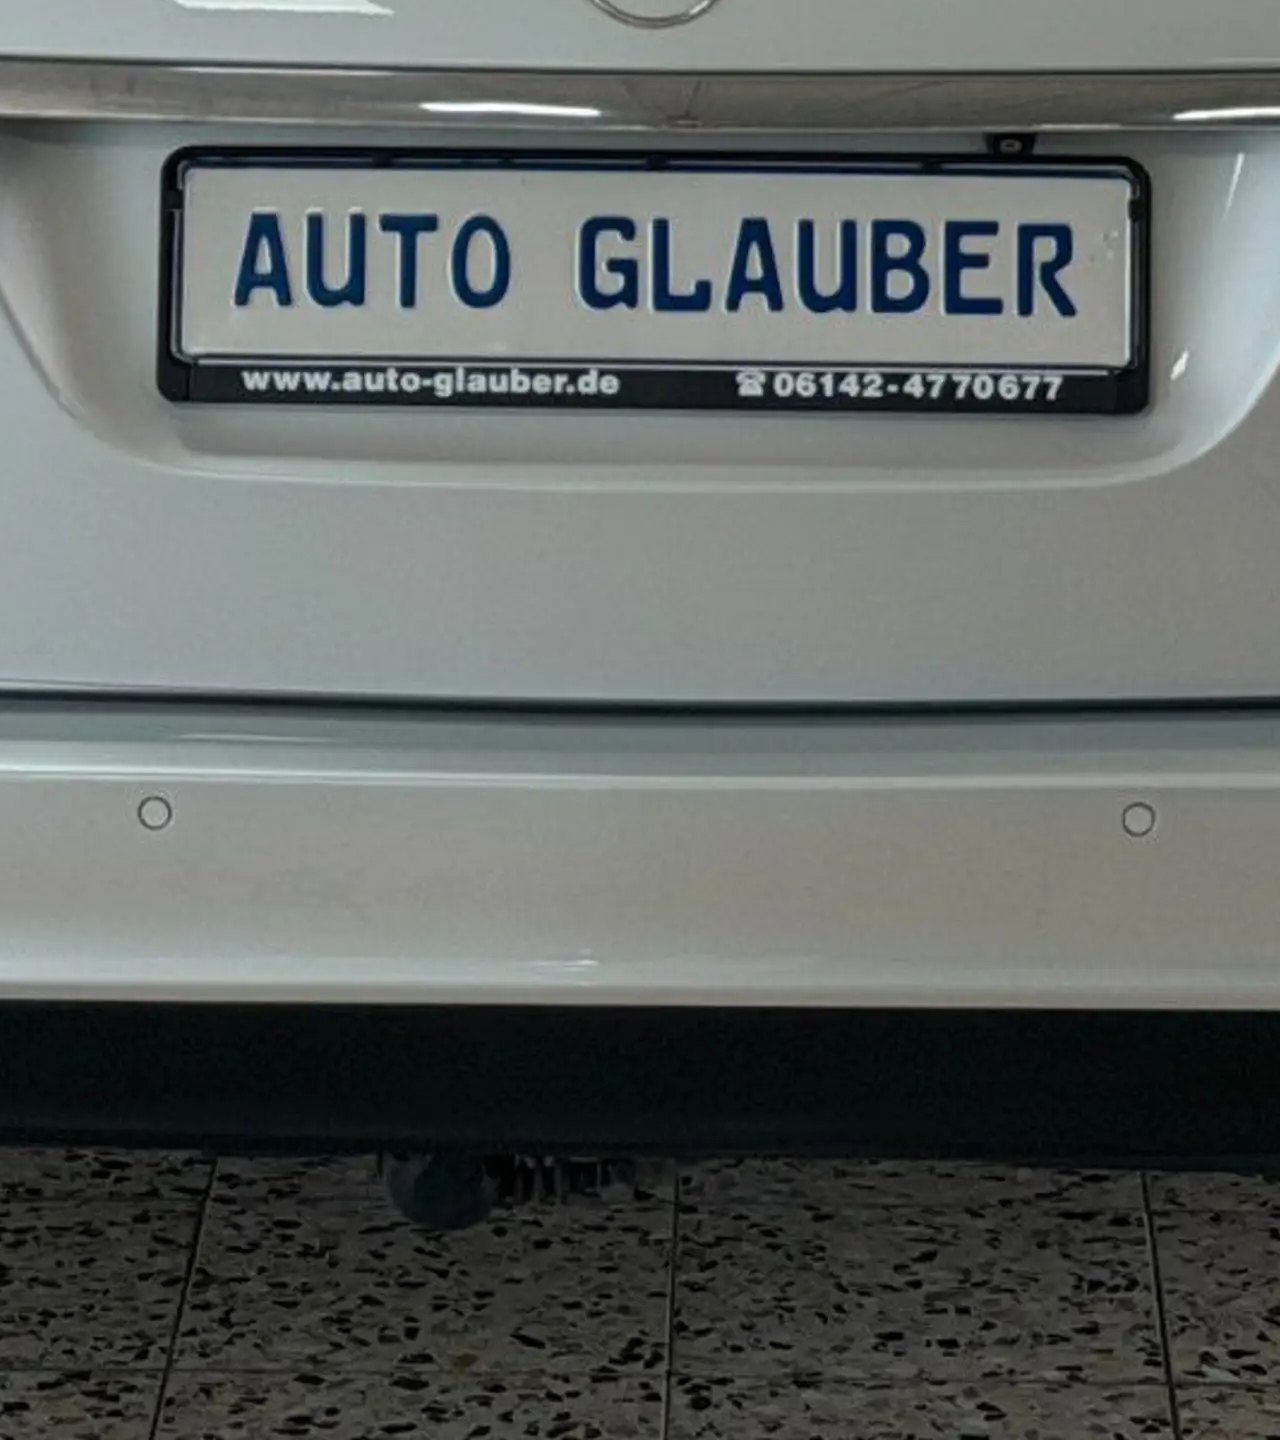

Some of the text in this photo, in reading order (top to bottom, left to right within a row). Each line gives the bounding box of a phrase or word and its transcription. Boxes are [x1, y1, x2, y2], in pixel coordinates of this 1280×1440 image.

[233, 210, 1079, 318] AUTO GLAUBER
[241, 367, 620, 398] www.auto-glauber.de
